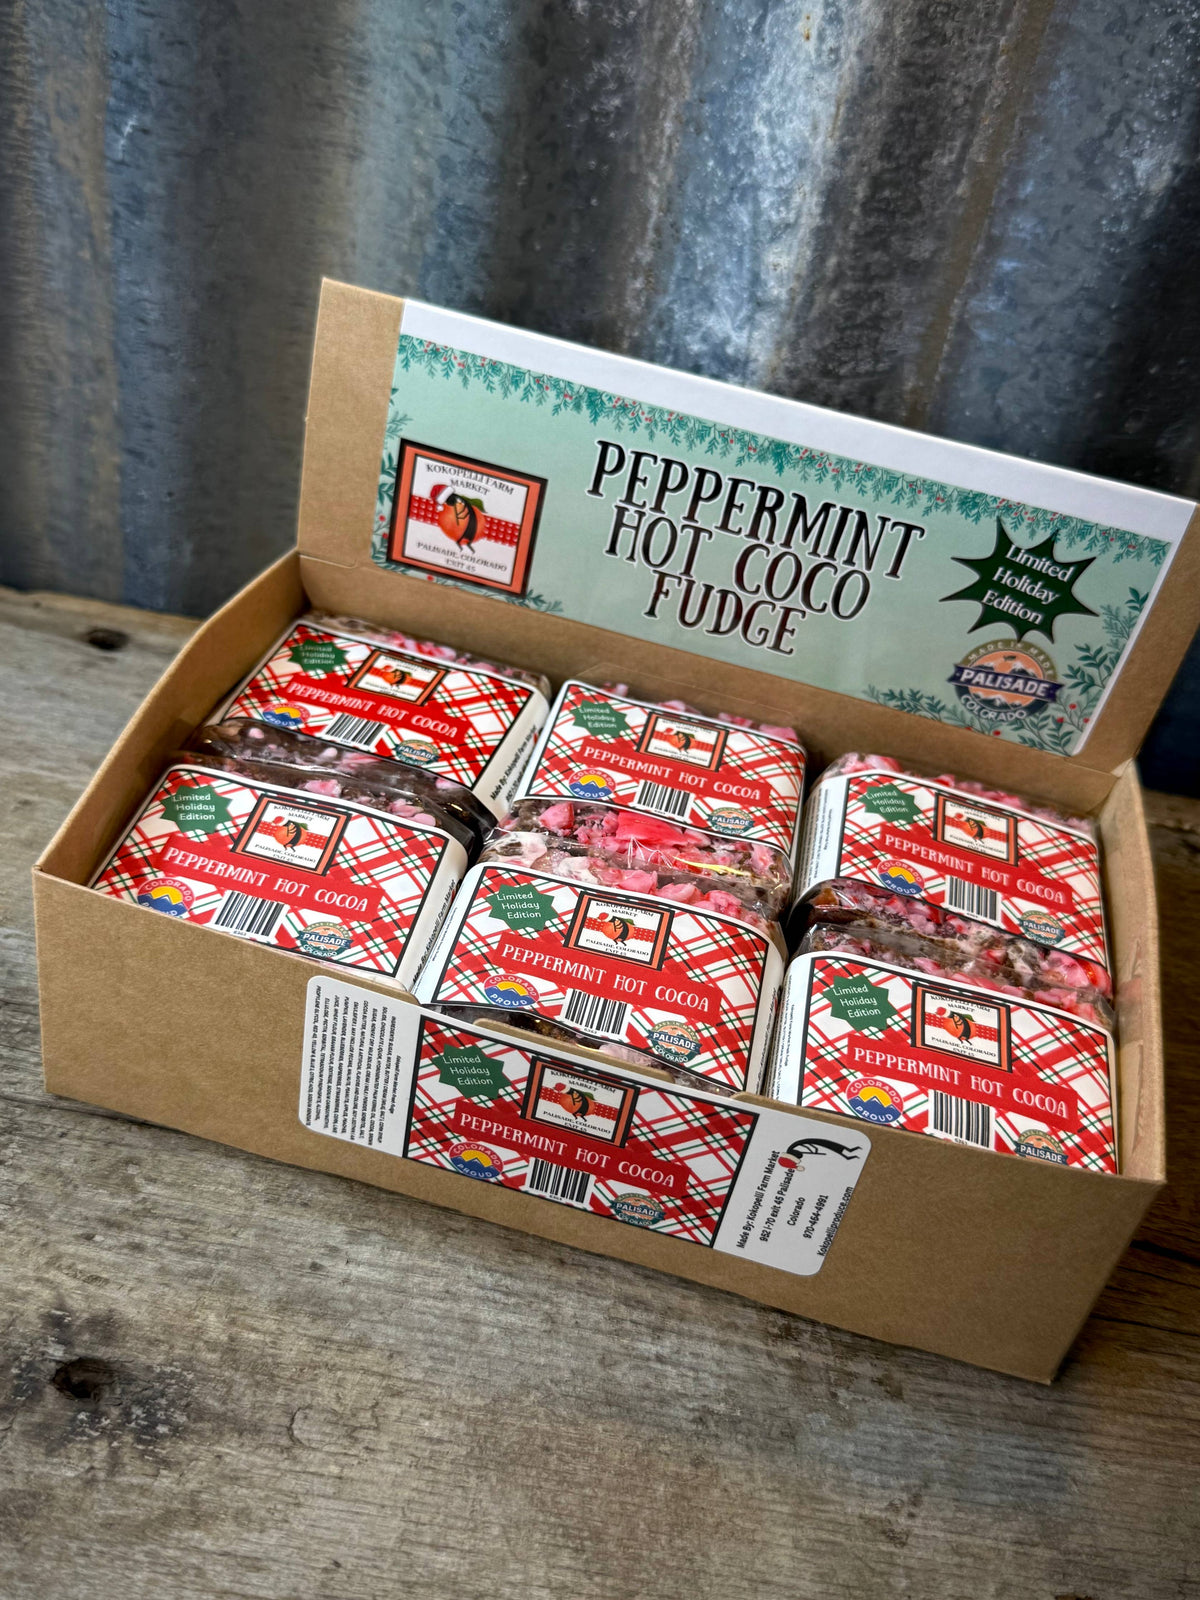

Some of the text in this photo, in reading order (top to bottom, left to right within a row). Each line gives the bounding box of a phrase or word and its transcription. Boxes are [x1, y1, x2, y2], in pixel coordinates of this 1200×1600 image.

[426, 463, 514, 496] KOKOPELLI FARM
[450, 480, 490, 496] MARKET
[587, 440, 925, 579] PEPPERMINT
[460, 553, 508, 572] COLORADO
[466, 564, 476, 573] 45
[605, 504, 870, 620] HOT COCO
[1005, 544, 1074, 582] Limited
[992, 567, 1060, 606] Holiday
[643, 570, 806, 655] FUDGE
[981, 590, 1044, 625] Edition
[960, 669, 1050, 696] PALISADE
[287, 682, 376, 712] PEPPERMINT
[377, 702, 410, 722] HOT
[410, 714, 458, 738] COCOA
[961, 695, 1028, 722] COLORADO
[583, 714, 616, 722] Holiday
[398, 745, 436, 760] PALISADE
[584, 746, 674, 778] PEPPERMINT
[678, 772, 708, 788] HOT
[713, 780, 761, 800] COCOA
[172, 793, 212, 802] Limited
[574, 788, 606, 798] PROUD
[865, 791, 898, 800] Limited
[176, 803, 216, 812] Holiday
[872, 798, 906, 806] Holiday
[879, 806, 910, 814] Edition
[180, 812, 216, 821] Edition
[712, 816, 750, 826] PALISADE
[880, 860, 922, 882] COLORADO
[885, 834, 974, 874] PEPPERMINT
[981, 866, 1011, 886] HOT
[1016, 878, 1065, 904] COCOA
[164, 847, 368, 912] PEPPERMINT HOT COCOA
[884, 880, 917, 894] PROUD
[145, 880, 193, 902] COLORADO
[496, 892, 534, 901] Limited
[438, 902, 448, 920] Farm
[444, 880, 456, 903] Market
[502, 901, 540, 910] Holiday
[506, 911, 542, 920] Edition
[611, 908, 638, 918] MARKET
[1022, 920, 1061, 935] PALISADE
[302, 933, 346, 946] PALISADE
[489, 975, 538, 996] COLORADO
[501, 944, 710, 1012] PEPPERMINT HOT COCOA
[833, 984, 869, 996] Limited
[490, 993, 528, 1006] PROUD
[840, 996, 878, 1006] Holiday
[947, 1002, 976, 1013] MARKET
[847, 1008, 882, 1018] Edition
[652, 1032, 697, 1050] PALISADE
[443, 1056, 482, 1064] Limited
[654, 1044, 688, 1063] COLORADO
[450, 1066, 491, 1076] Holiday
[458, 1077, 494, 1086] Edition
[568, 1080, 598, 1092] MARKET
[854, 1046, 1068, 1119] PEPPERMINT HOT COCOA
[850, 1079, 900, 1103] COLORADO
[855, 1106, 894, 1122] PROUD
[575, 1119, 612, 1134] COLORADO
[453, 1143, 501, 1166] COLORADO
[460, 1112, 675, 1188] PEPPERMINT HOT COCOA
[1020, 1144, 1063, 1164] PALISADE
[457, 1163, 492, 1178] PROUD
[778, 1168, 795, 1196] Palisade
[736, 1150, 780, 1248] Made By: Kokopelli Farm Market
[776, 1190, 784, 1206] 45
[616, 1202, 660, 1218] PALISADE
[770, 1200, 781, 1220] exit
[787, 1196, 806, 1226] Colorado
[803, 1194, 828, 1239] 970-464-4991
[817, 1186, 854, 1256] Kokopelliproduce.com
[760, 1226, 772, 1242] 952
